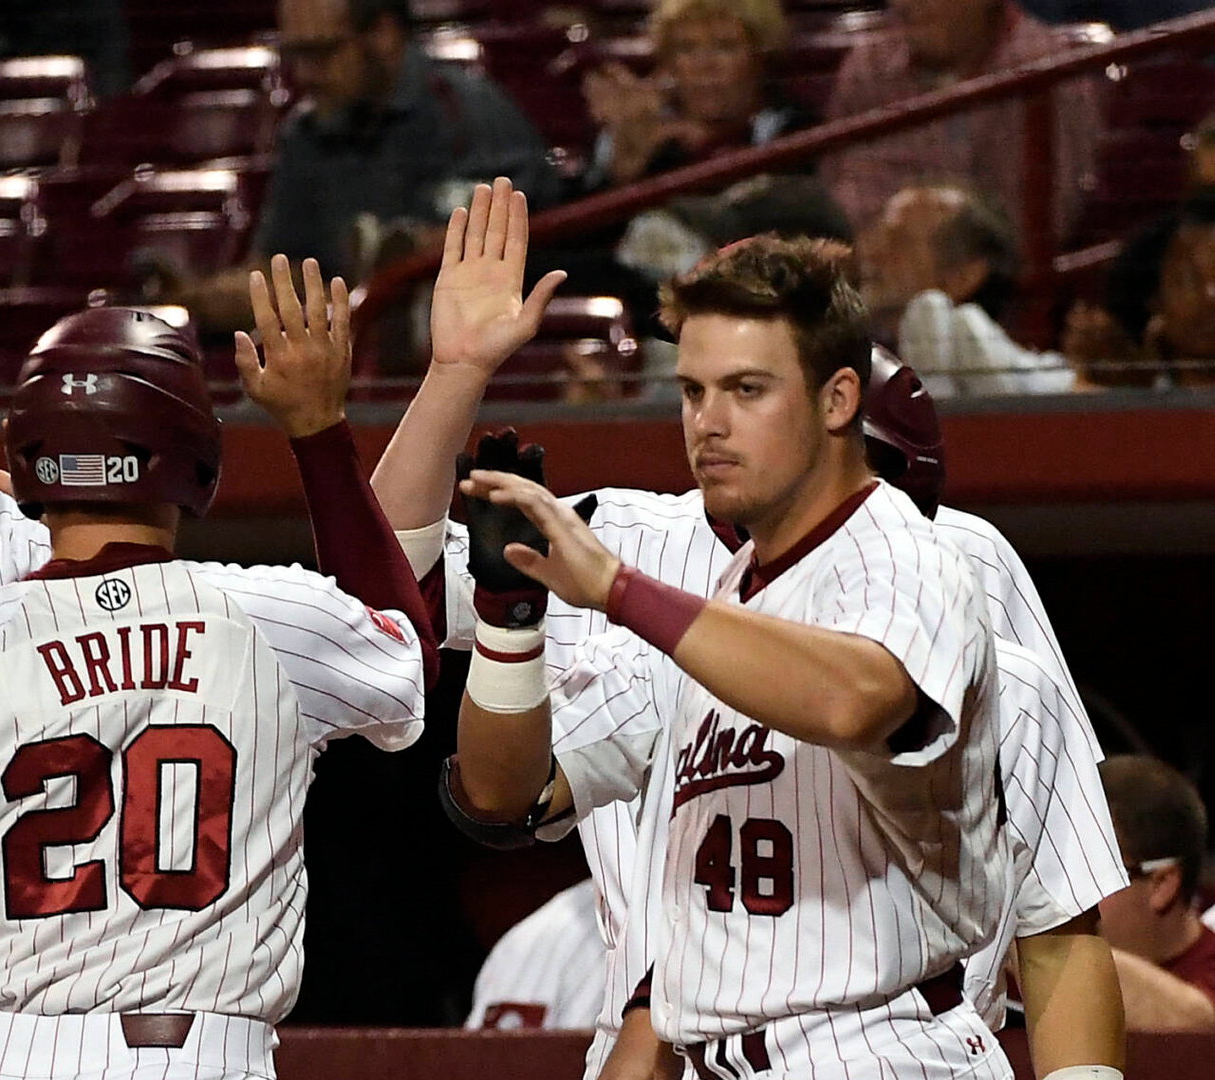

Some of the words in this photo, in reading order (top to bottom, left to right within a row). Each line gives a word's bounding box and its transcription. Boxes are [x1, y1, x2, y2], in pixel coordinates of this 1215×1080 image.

[107, 455, 140, 483] 20
[96, 580, 131, 611] SEC
[36, 620, 206, 707] BRIDE
[0, 723, 238, 921] 20
[693, 814, 795, 917] 48
